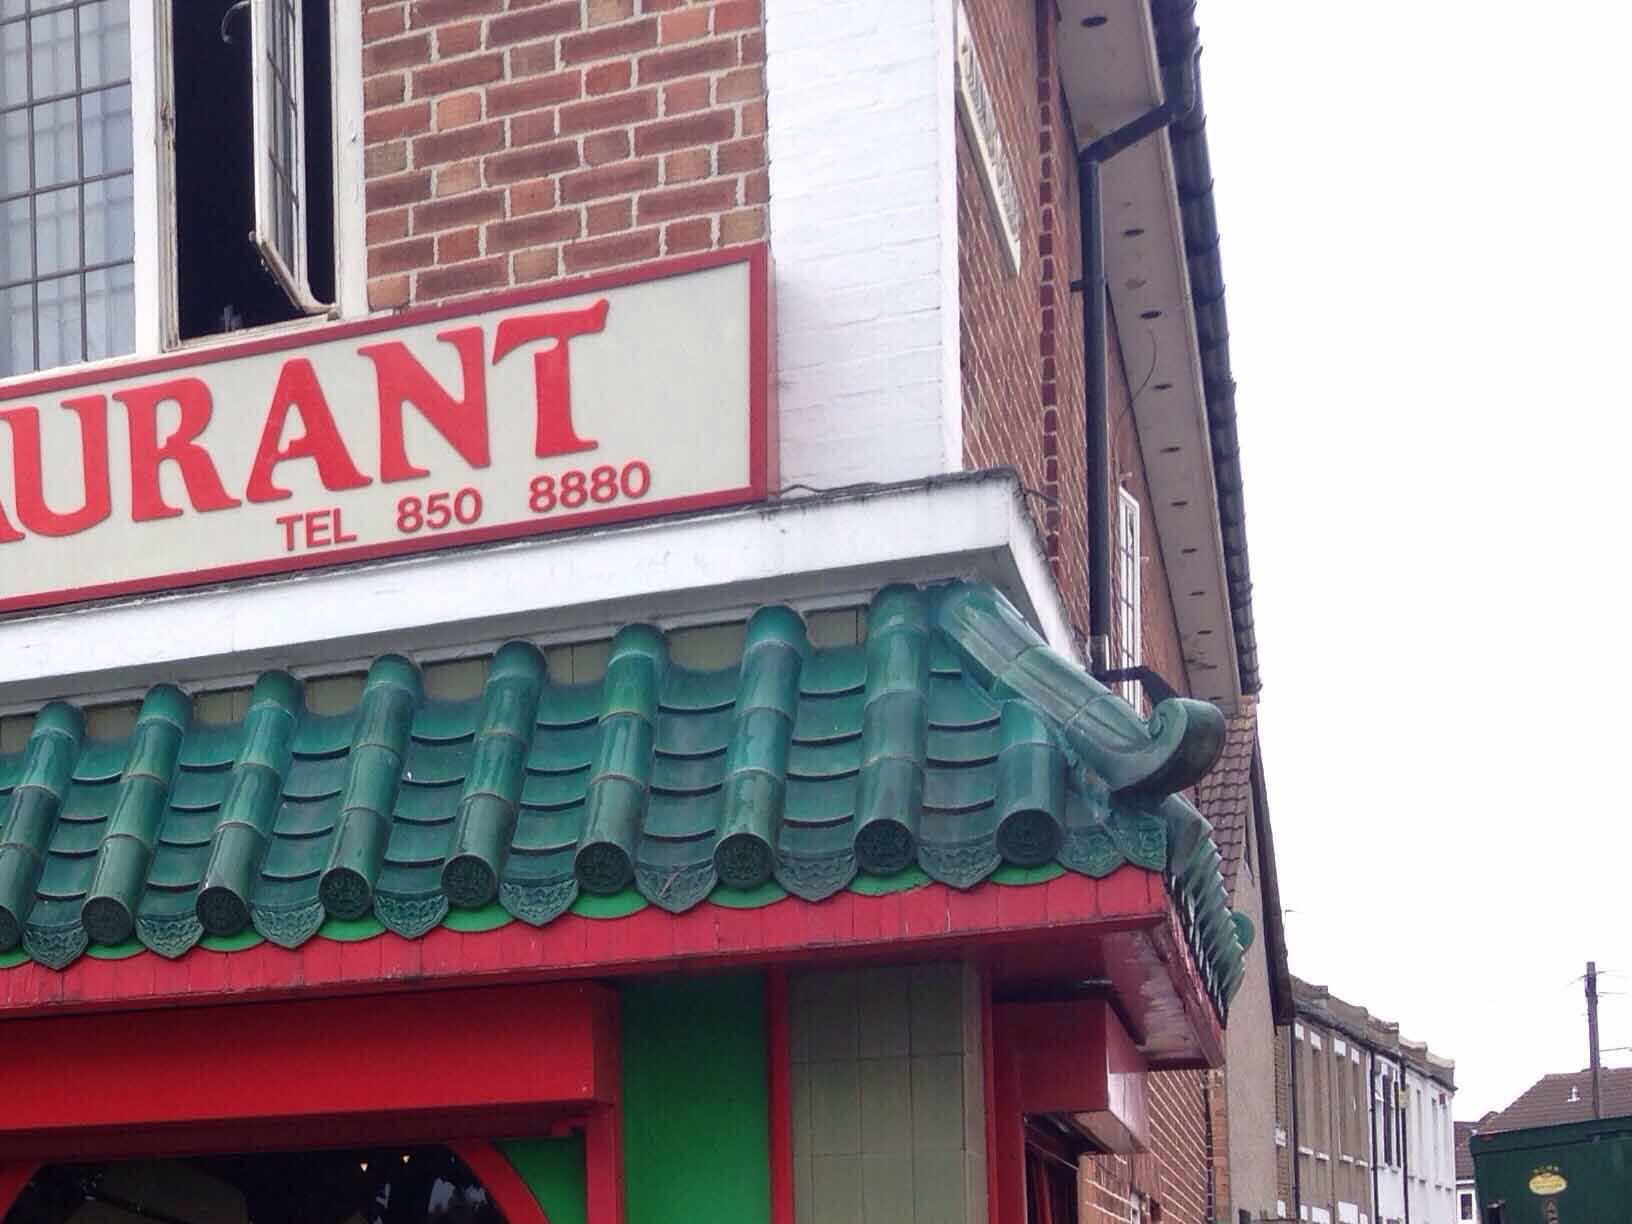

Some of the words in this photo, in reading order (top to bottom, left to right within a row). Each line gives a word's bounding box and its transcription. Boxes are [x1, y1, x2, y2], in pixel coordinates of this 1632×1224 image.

[276, 508, 357, 551] TEL
[396, 488, 483, 534] 850
[528, 461, 651, 514] 8880
